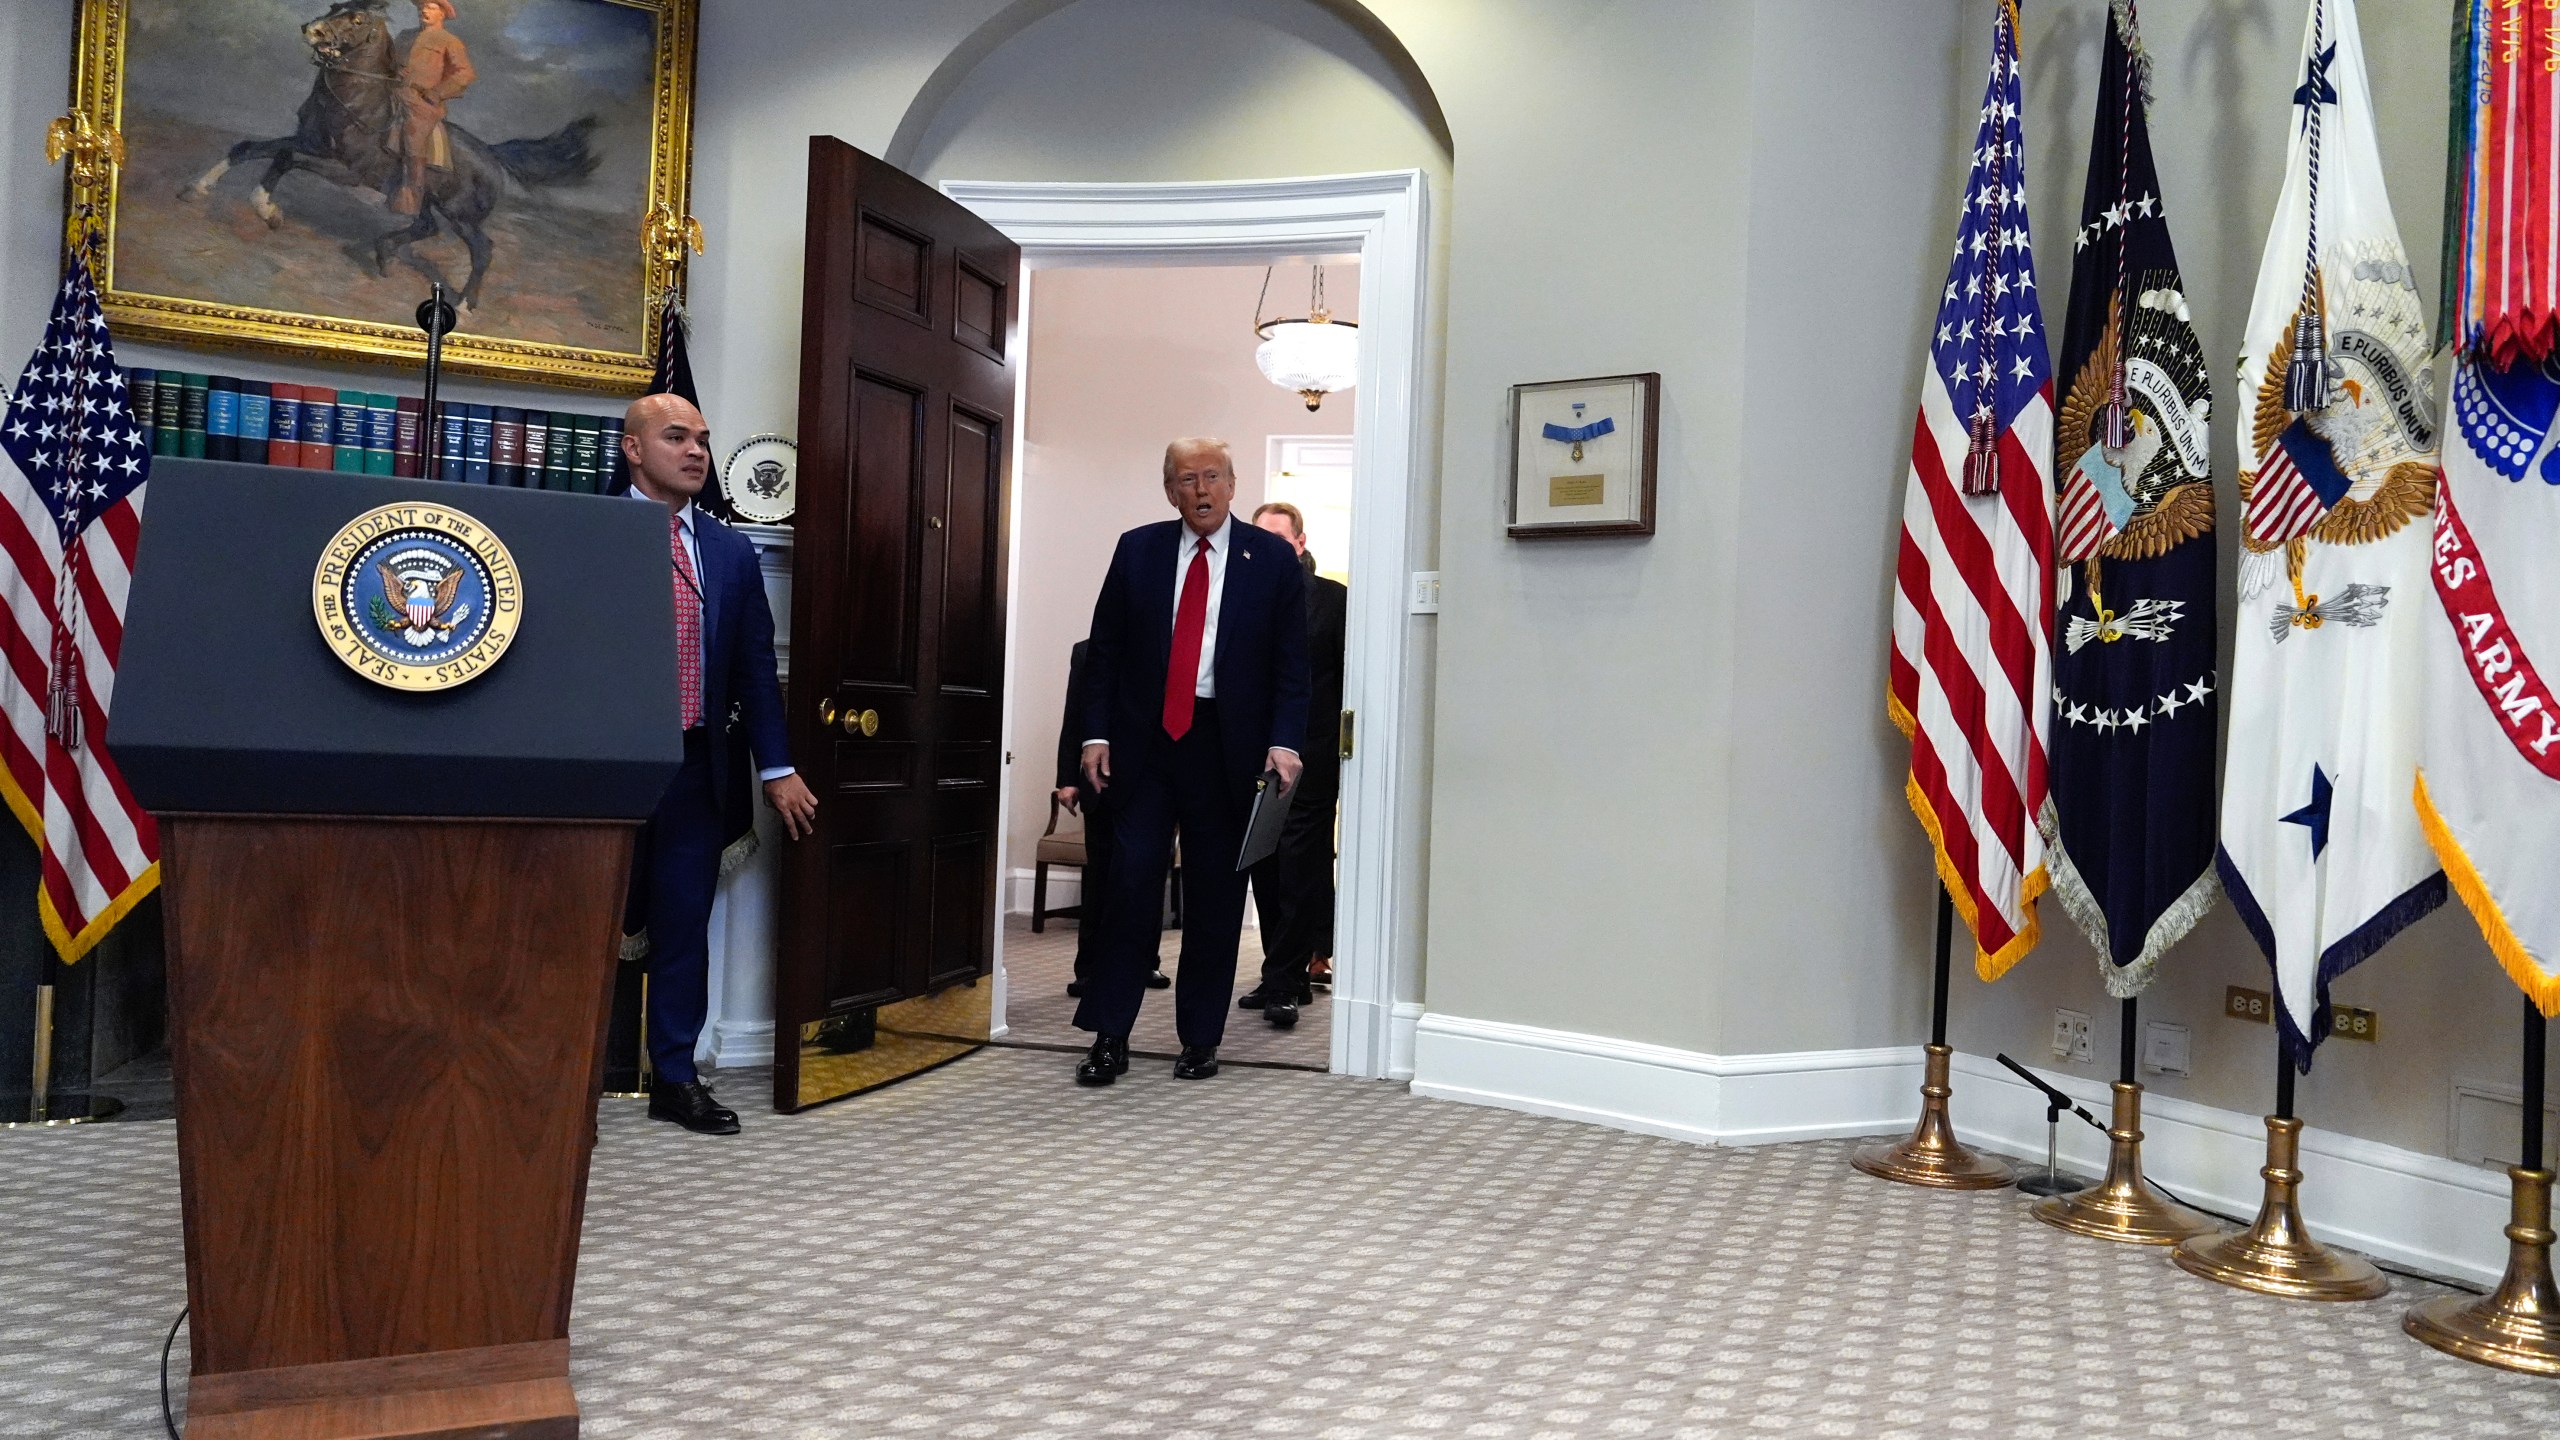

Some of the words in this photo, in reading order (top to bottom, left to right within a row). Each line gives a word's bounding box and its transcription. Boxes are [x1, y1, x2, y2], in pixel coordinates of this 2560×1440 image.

[2341, 336, 2352, 350] E
[2353, 338, 2408, 402] PLURIBUS
[2398, 400, 2432, 445] UNUM
[2130, 367, 2139, 382] E
[2141, 371, 2185, 431] PLURIBUS
[2179, 429, 2206, 471] UNUM
[424, 512, 444, 526] OF
[447, 517, 473, 538] THE
[322, 509, 418, 588] PRESIDENT
[476, 536, 516, 613] UNITED
[322, 593, 339, 621] THE
[330, 623, 347, 641] OF
[347, 640, 399, 682] SEAL
[436, 628, 506, 684] STATES
[2458, 611, 2560, 757] ARMY
